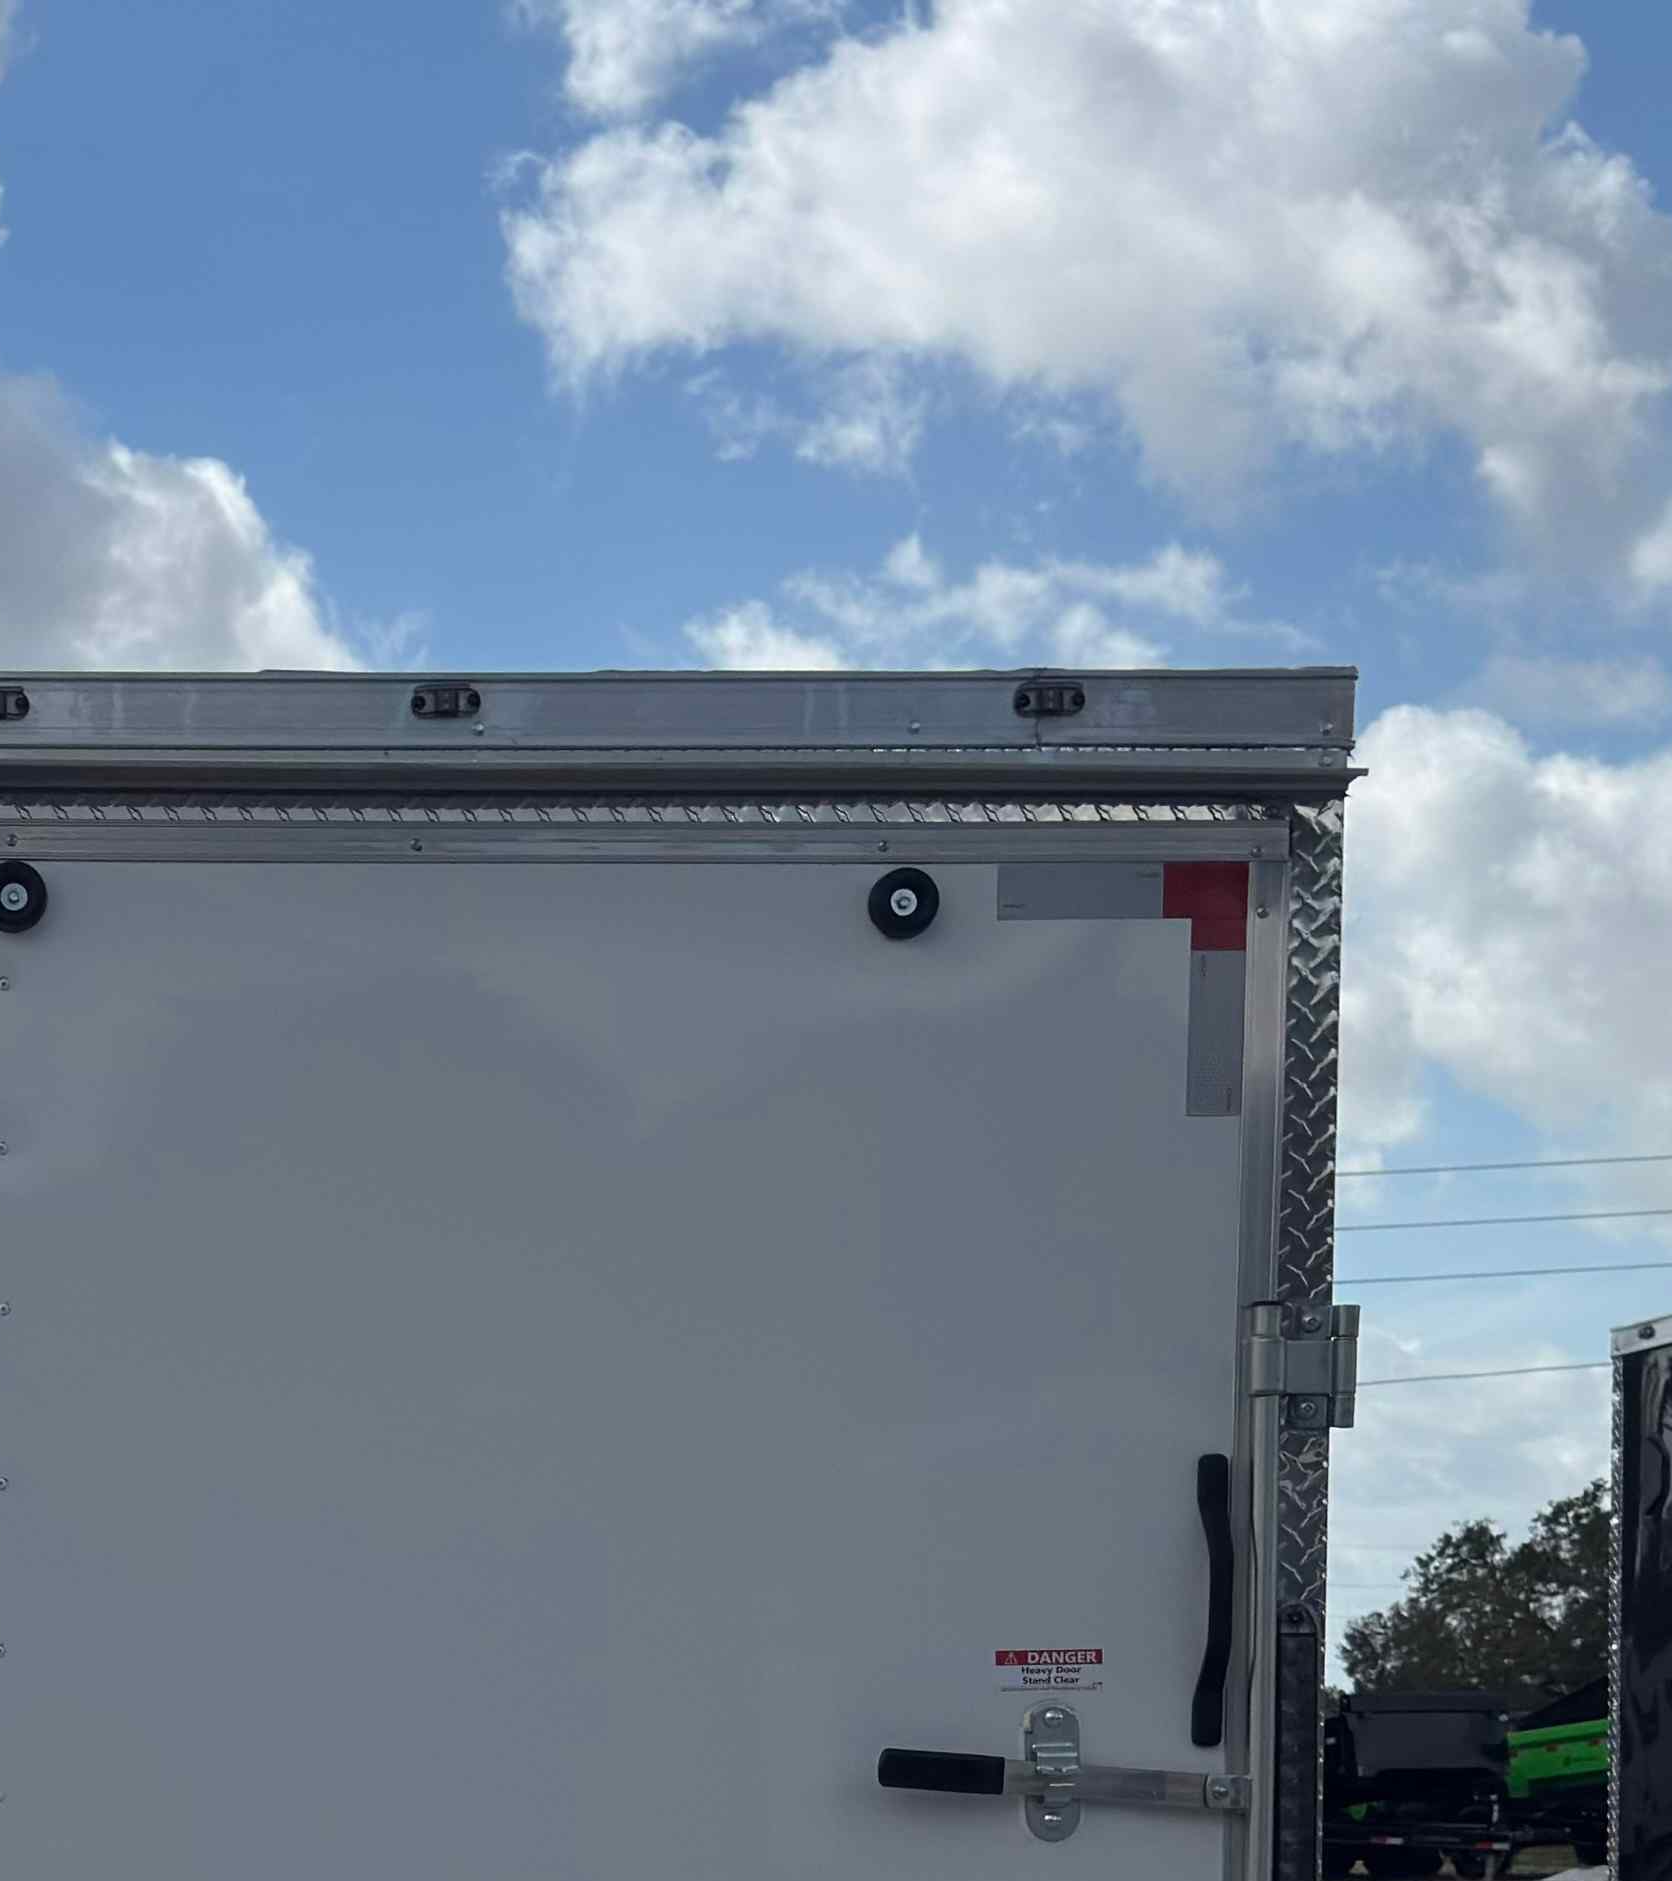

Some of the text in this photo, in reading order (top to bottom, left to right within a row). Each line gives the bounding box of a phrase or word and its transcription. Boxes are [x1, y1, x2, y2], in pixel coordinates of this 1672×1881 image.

[1027, 1651, 1097, 1664] DANGER
[1021, 1666, 1081, 1675] Heavy Door
[1022, 1676, 1080, 1685] Stand Clear
